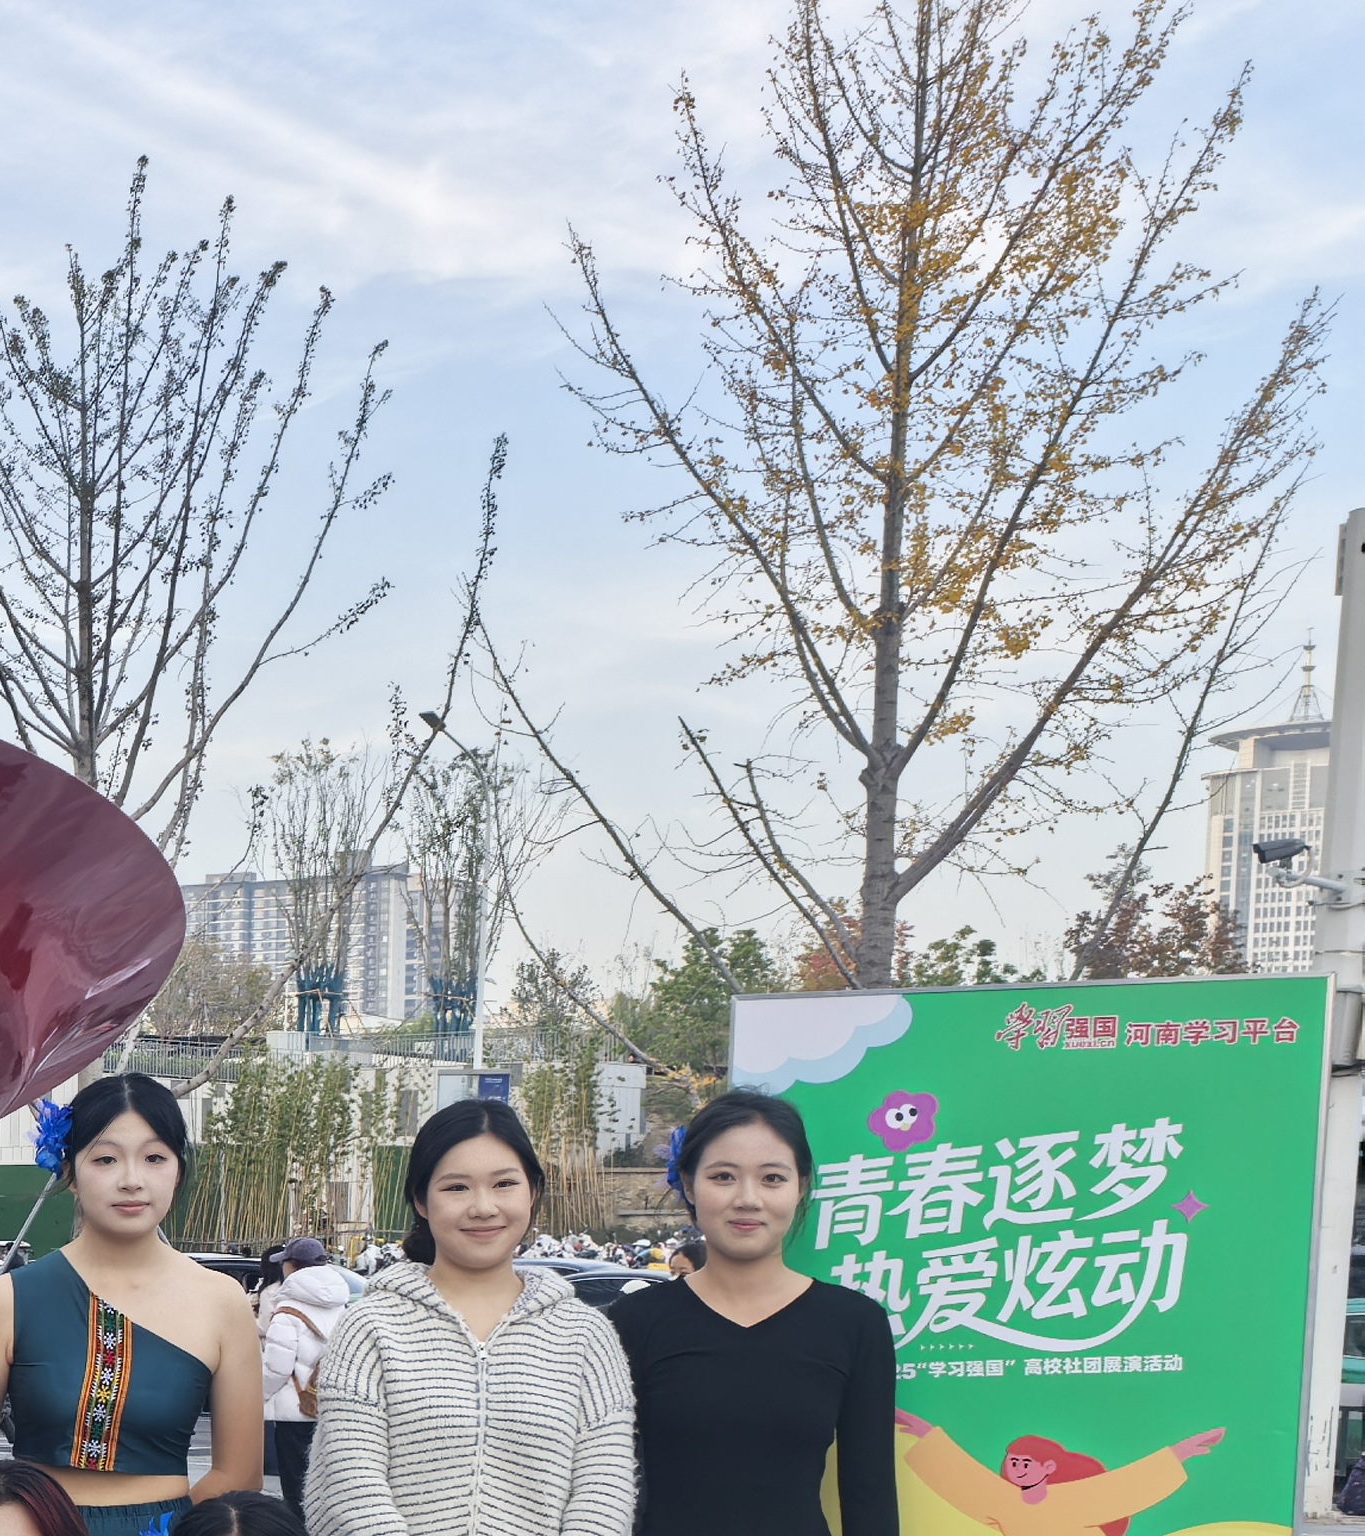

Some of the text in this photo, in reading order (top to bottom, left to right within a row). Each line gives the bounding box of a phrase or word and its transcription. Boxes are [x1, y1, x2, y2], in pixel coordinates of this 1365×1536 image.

[1124, 1017, 1300, 1047] 河南学习平台
[812, 1115, 1184, 1251] 青春逐梦
[831, 1218, 1189, 1353] 热爱炫动
[1024, 1354, 1184, 1376] 高校社团展演活动
